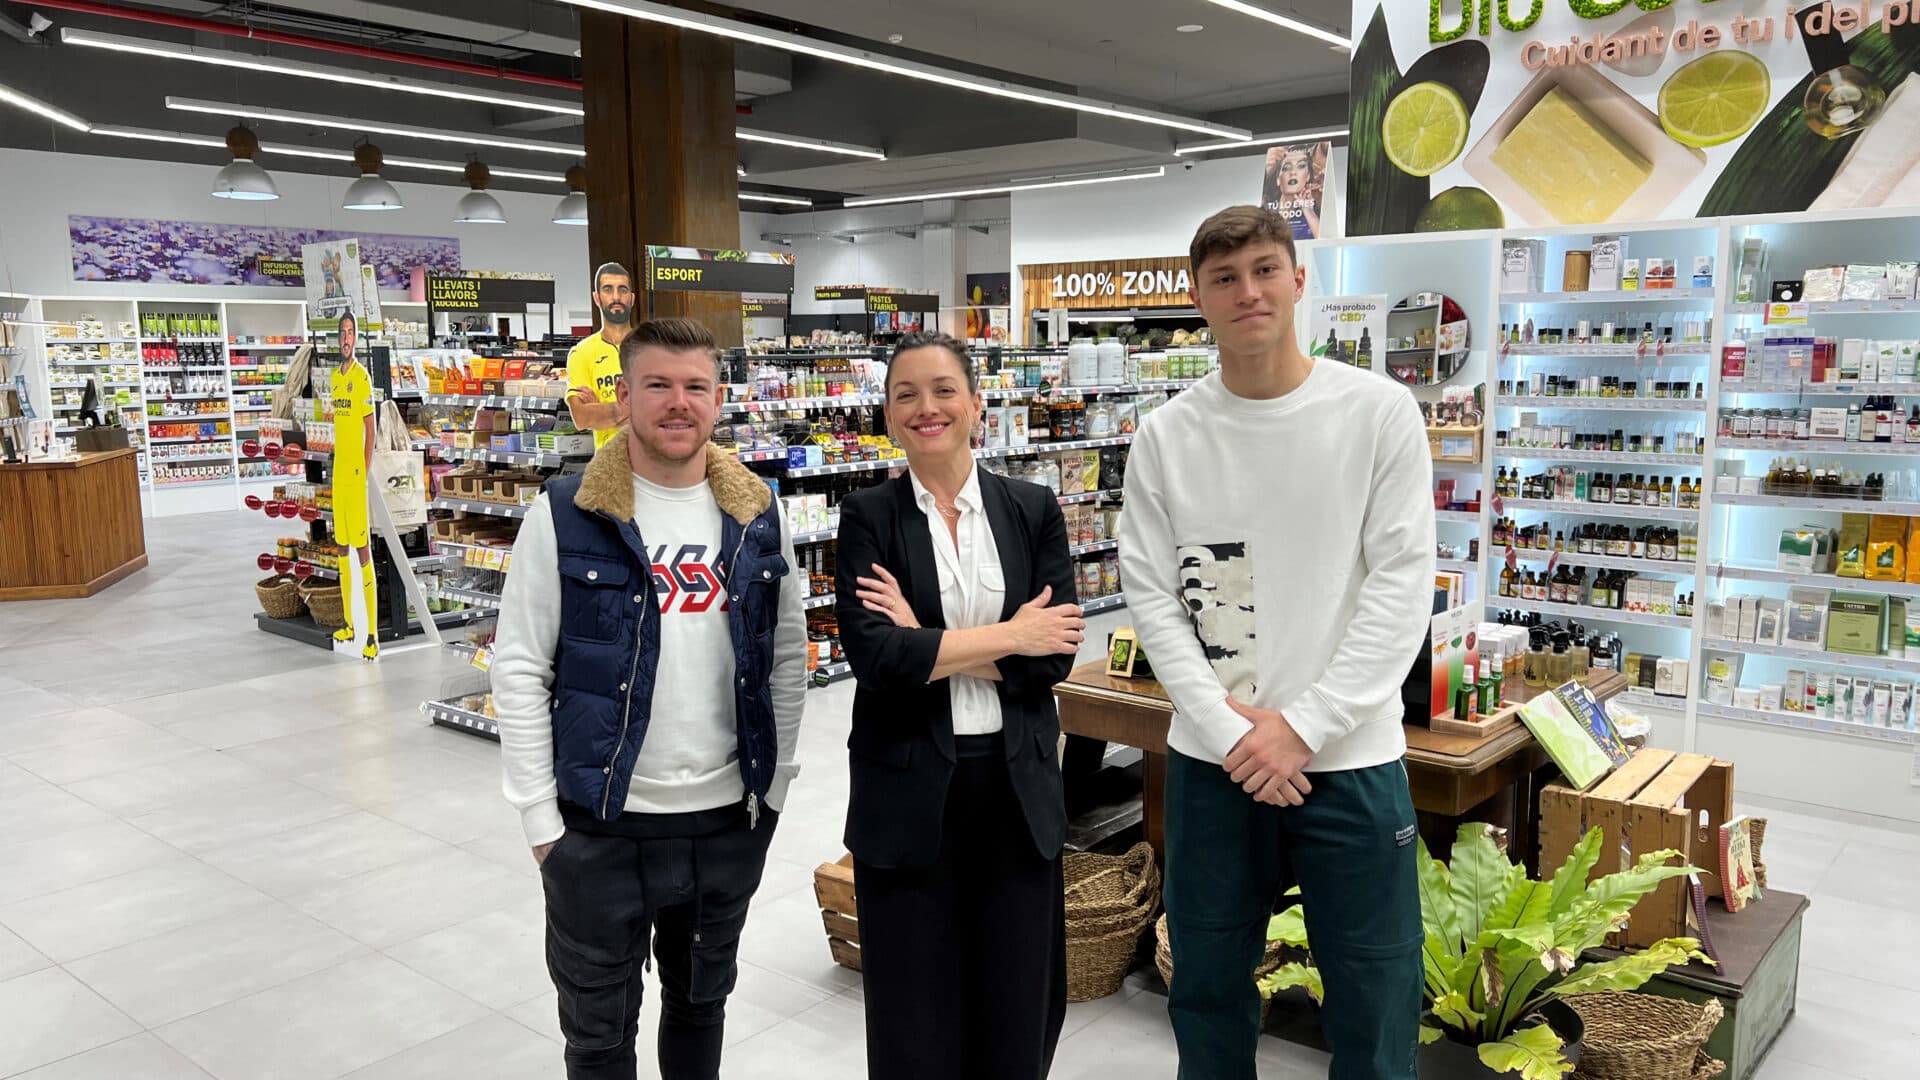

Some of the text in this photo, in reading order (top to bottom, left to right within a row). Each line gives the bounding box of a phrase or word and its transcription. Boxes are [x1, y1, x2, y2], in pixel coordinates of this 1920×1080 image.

[1520, 25, 1665, 71] Cuidant
[1672, 20, 1721, 51] de
[1731, 15, 1774, 44] tu
[1784, 7, 1797, 41] i
[1804, 0, 1872, 36] del
[1268, 198, 1315, 210] TÚ LO ERES
[656, 267, 704, 282] ESPORT
[432, 279, 475, 290] LLEVATS
[1051, 268, 1190, 299] 100% ZONA
[432, 290, 478, 300] LLAVORS
[870, 295, 892, 303] PASTES
[874, 303, 898, 311] FARINES
[1321, 303, 1376, 312] ¿Has probado
[1331, 313, 1338, 321] el
